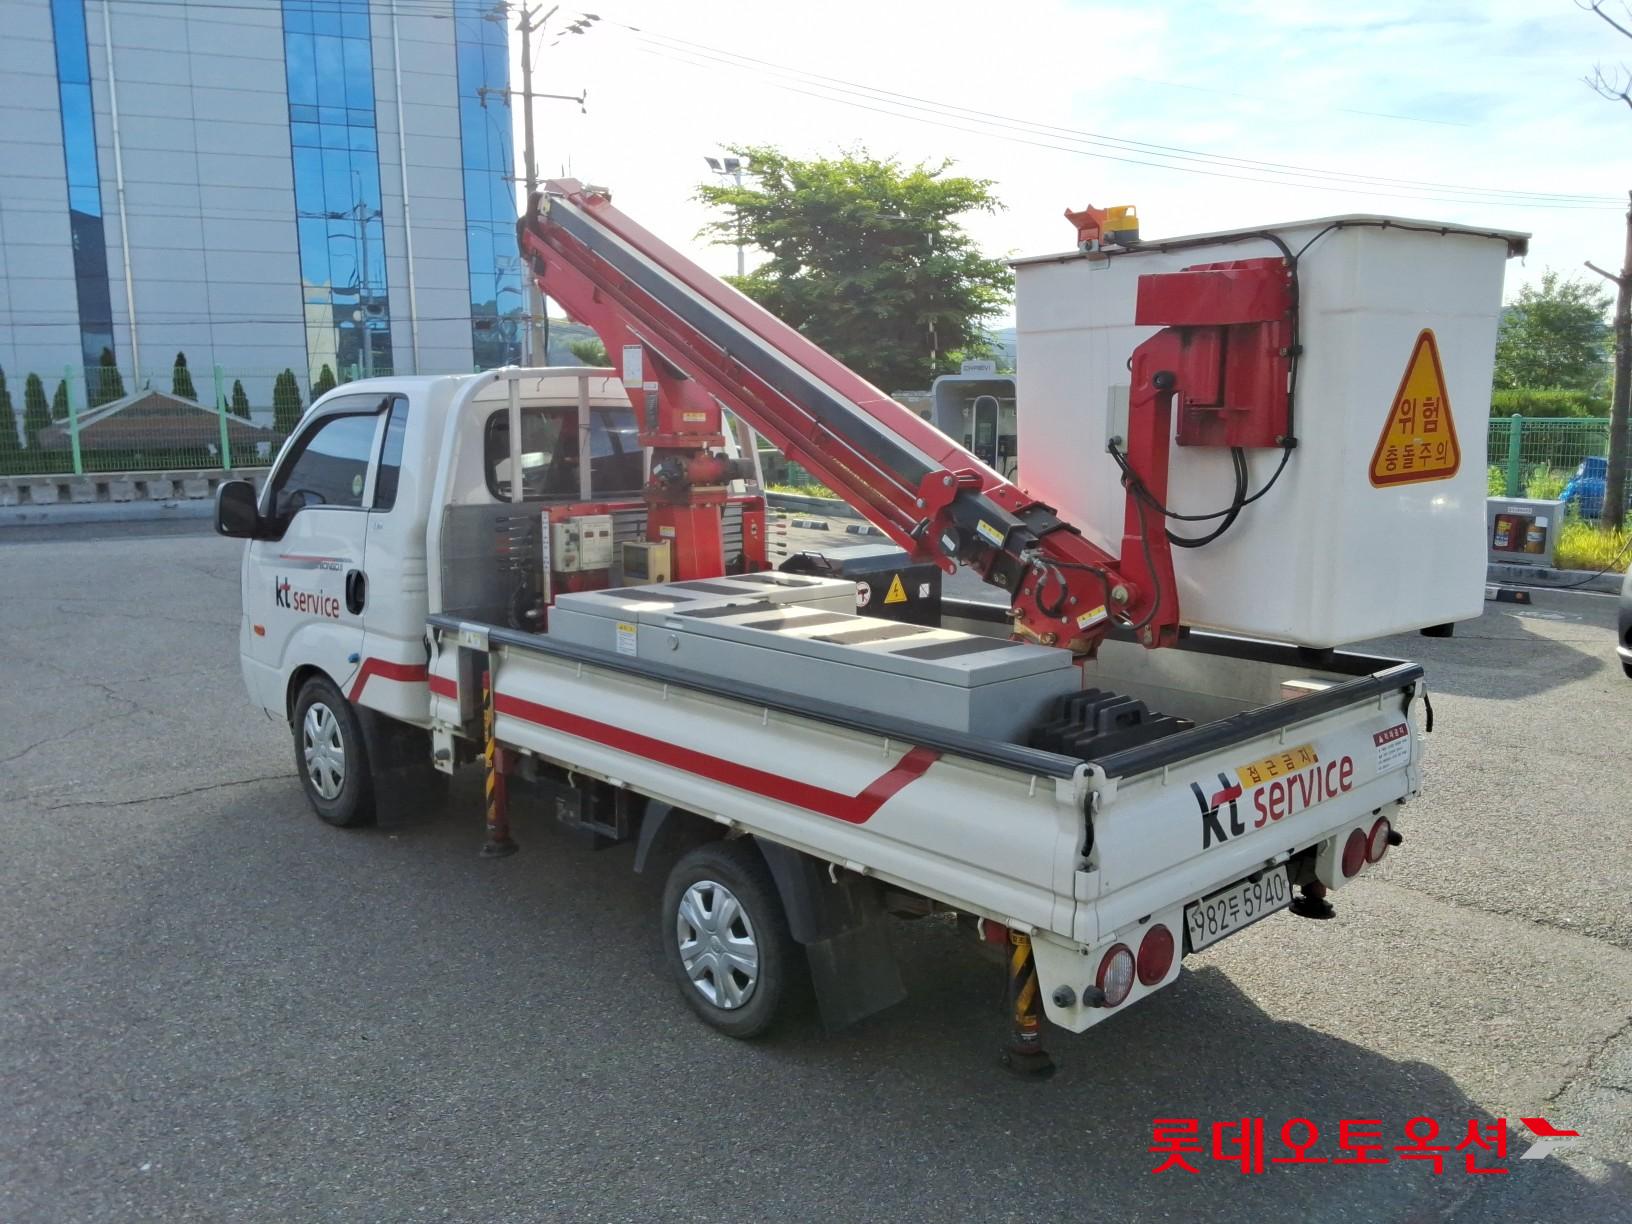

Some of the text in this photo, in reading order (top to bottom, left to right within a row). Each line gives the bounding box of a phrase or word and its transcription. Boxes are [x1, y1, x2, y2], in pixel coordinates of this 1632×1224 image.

[1399, 396, 1441, 435] 위험
[1385, 440, 1449, 472] 충돌주의
[275, 575, 340, 619] kt service
[1248, 747, 1312, 784] 접근금지
[1189, 754, 1354, 850] kt service
